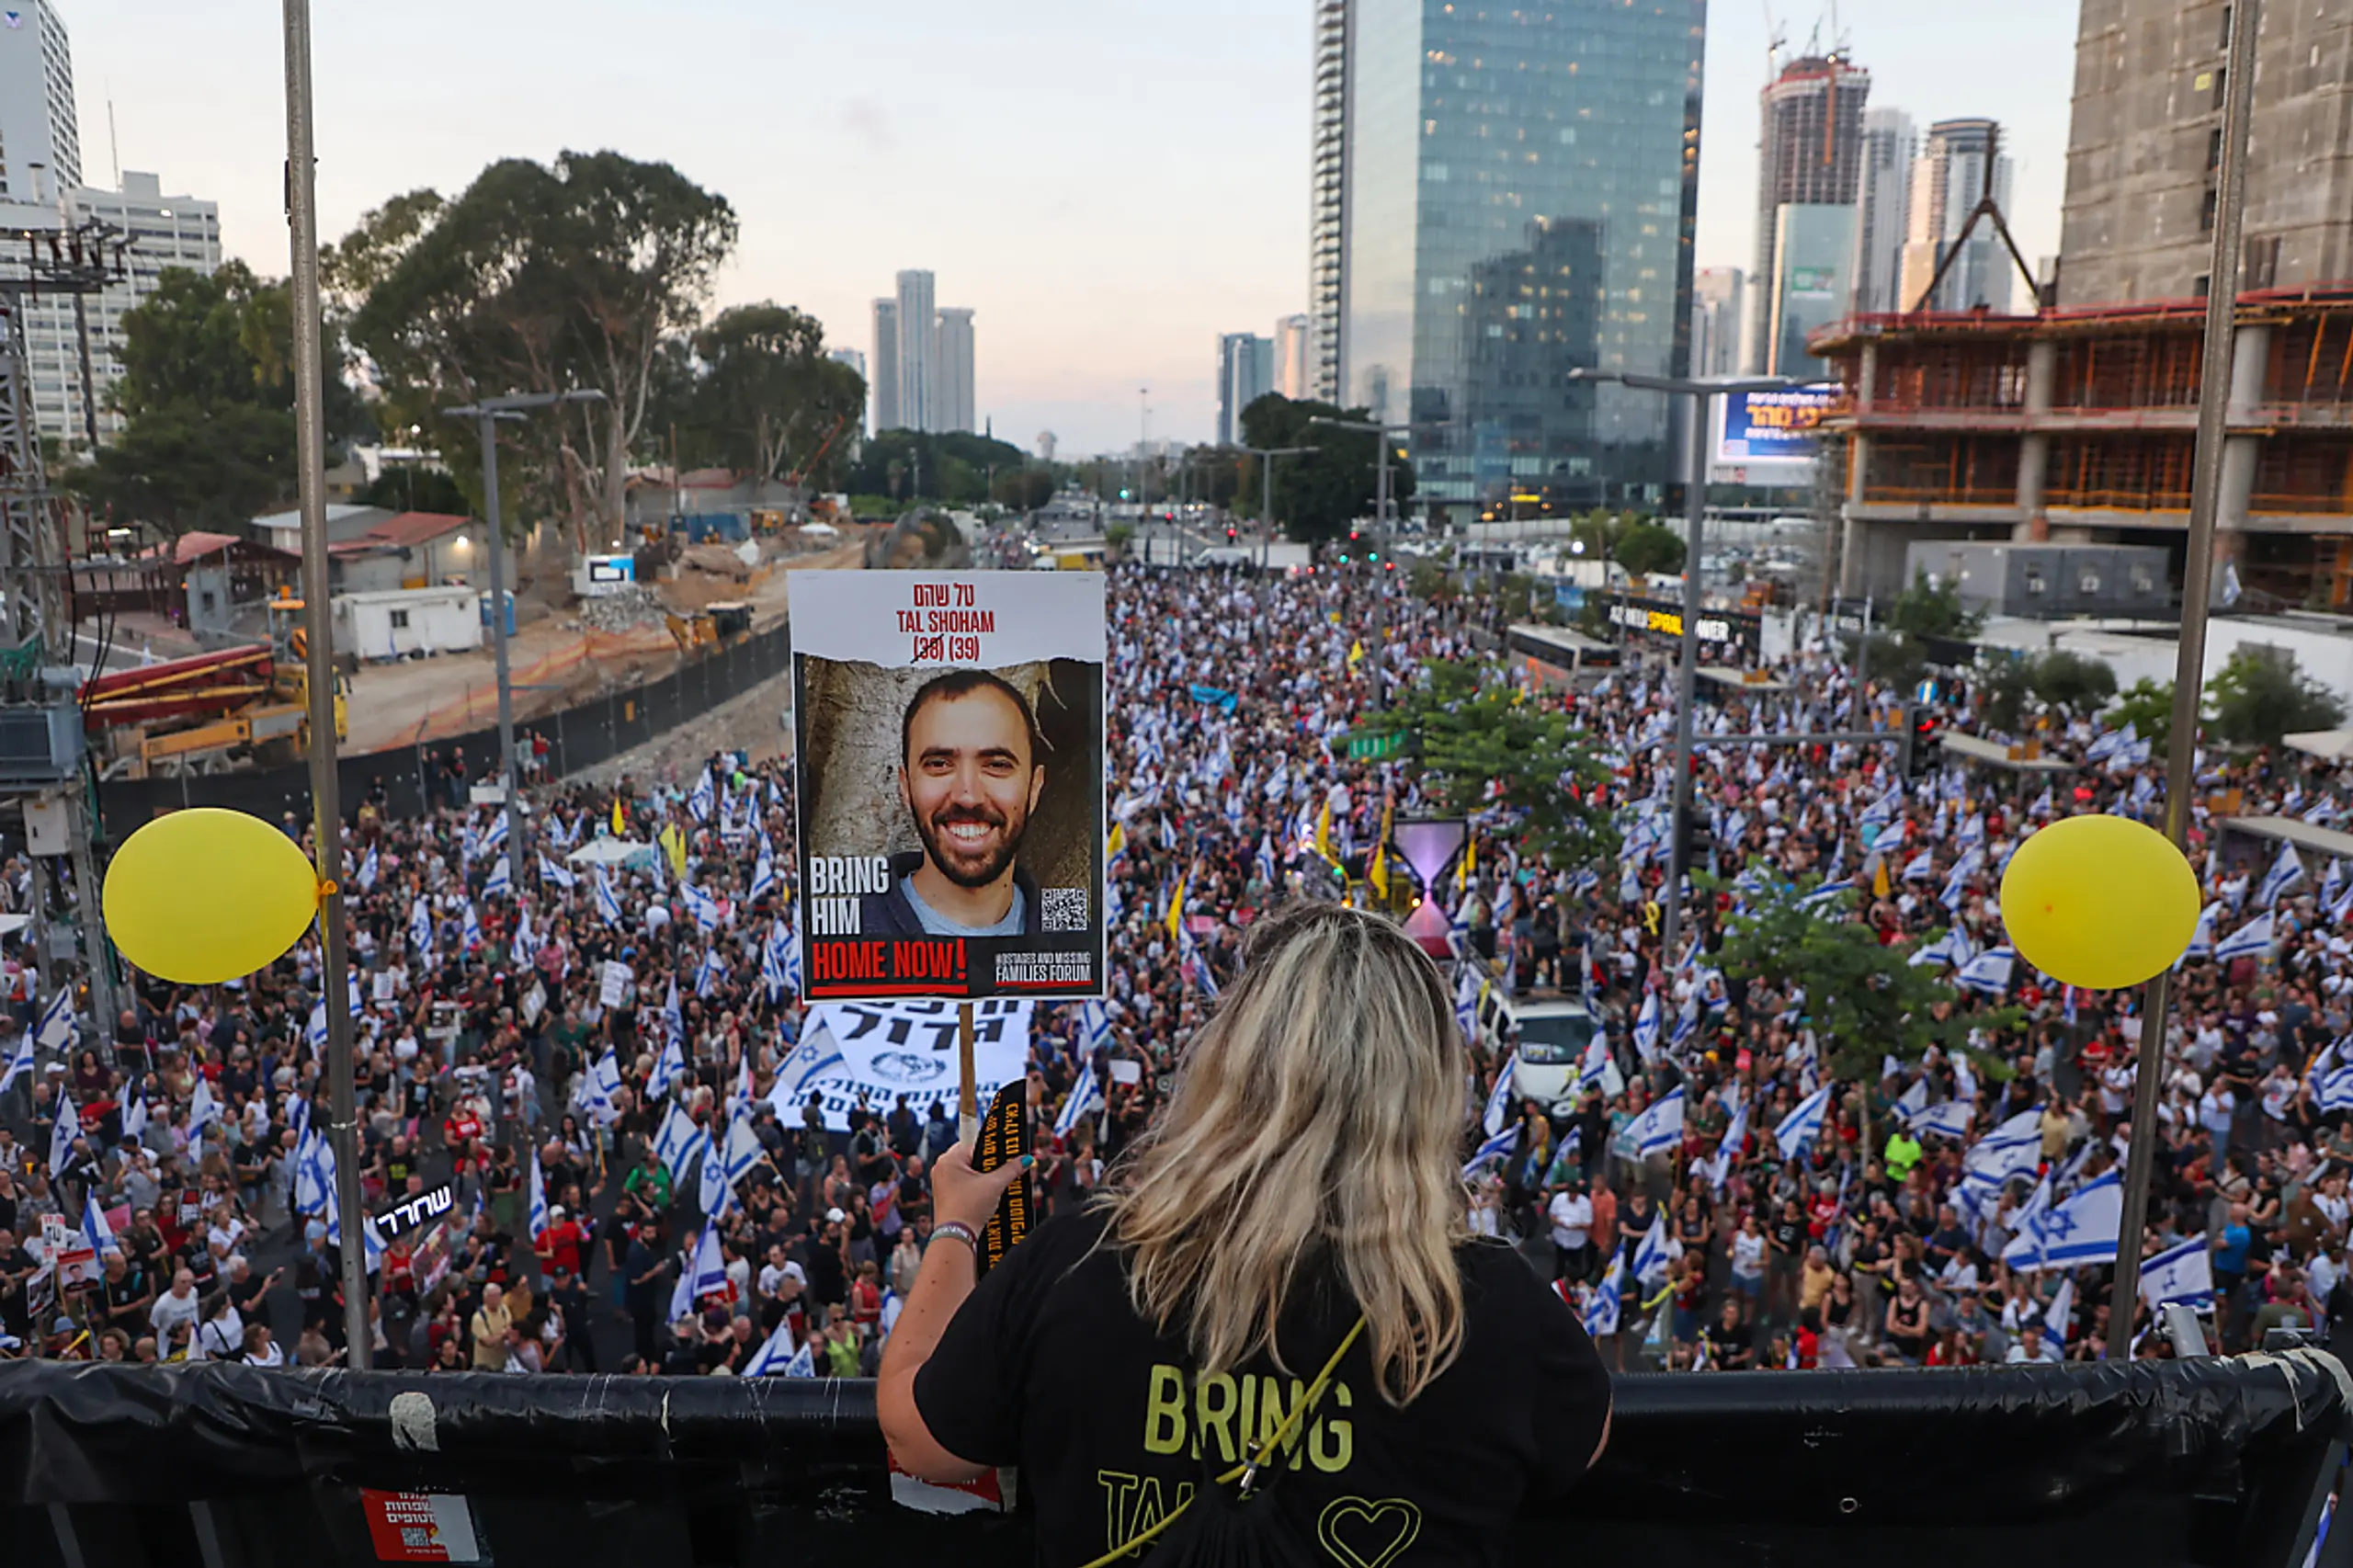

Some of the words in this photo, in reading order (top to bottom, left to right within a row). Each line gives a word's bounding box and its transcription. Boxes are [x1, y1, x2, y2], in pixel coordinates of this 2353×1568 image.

[914, 584, 949, 607] שהם
[953, 582, 974, 607] טל
[896, 610, 925, 632] TAL
[928, 610, 995, 632] SHOHAM
[949, 635, 980, 662] (39)
[810, 856, 890, 894] BRING
[811, 897, 860, 936] HIM
[813, 940, 886, 980] HOME
[893, 937, 967, 980] NOW!
[1038, 952, 1053, 963] AND
[1055, 952, 1092, 963] MISSING
[996, 965, 1048, 983] FAMILIES
[1050, 964, 1092, 982] FORUM
[837, 1006, 1006, 1051] גדול
[1143, 1364, 1353, 1472] BRING
